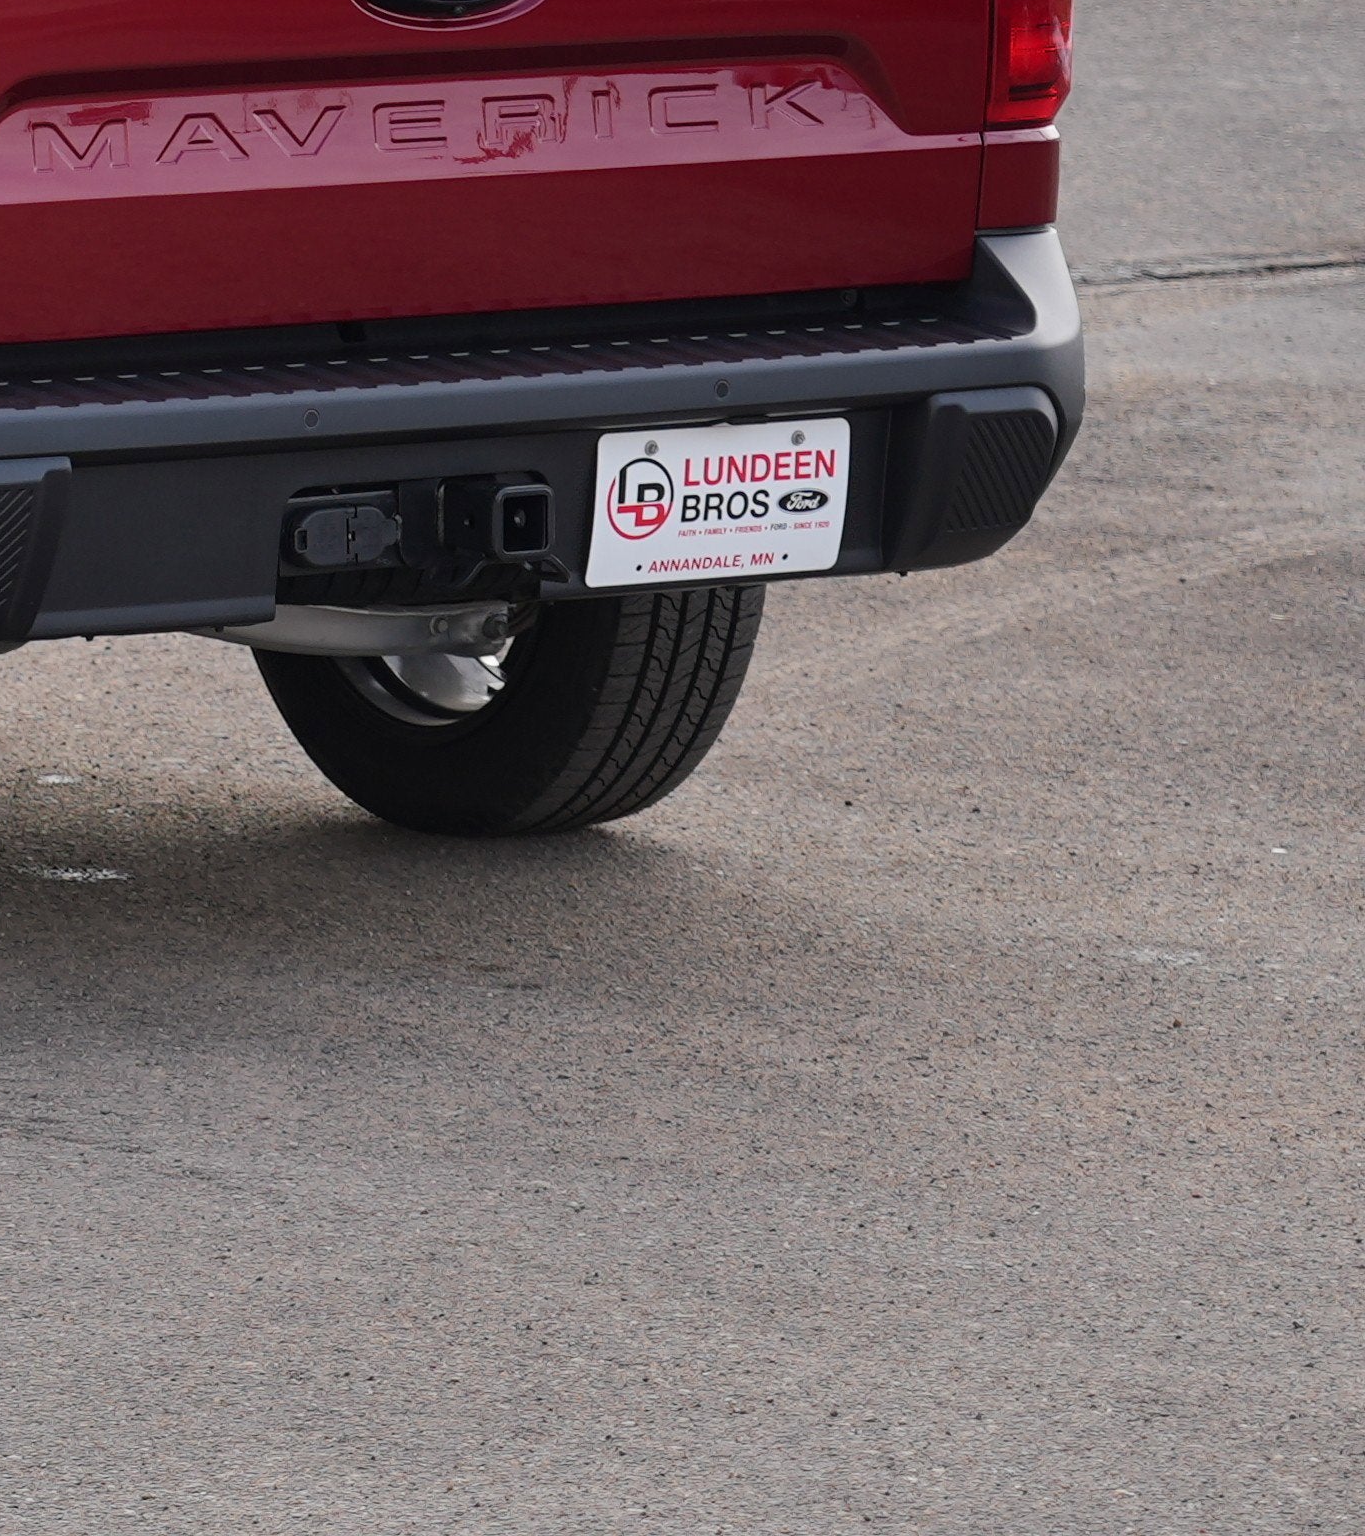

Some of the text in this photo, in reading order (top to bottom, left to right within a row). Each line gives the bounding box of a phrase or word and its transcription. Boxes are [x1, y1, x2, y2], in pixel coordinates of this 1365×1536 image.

[29, 79, 827, 174] MAVERICK
[683, 449, 836, 487] LUNDEEN
[680, 489, 770, 523] BROS
[786, 492, 820, 511] Ford
[647, 552, 776, 574] ANNANDALE, MN
